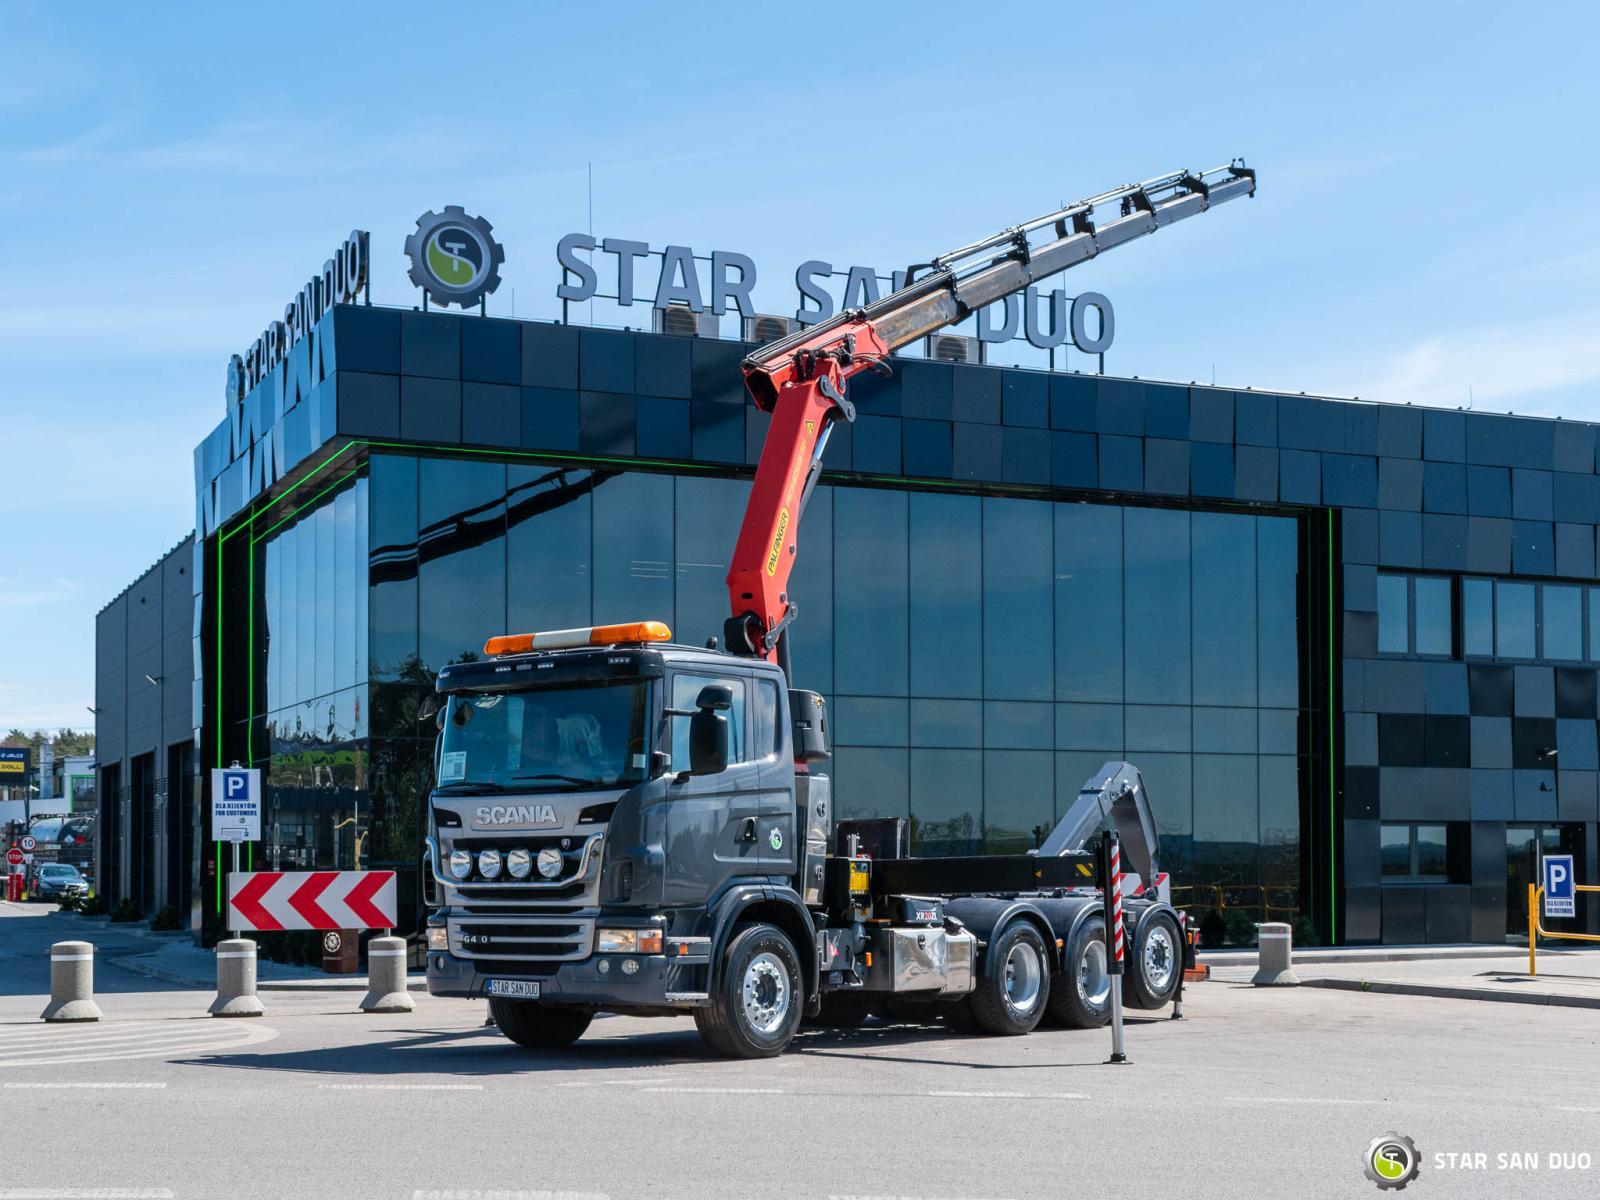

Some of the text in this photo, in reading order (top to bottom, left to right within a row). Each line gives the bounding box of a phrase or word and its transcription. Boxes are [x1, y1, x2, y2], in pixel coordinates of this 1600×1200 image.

[556, 233, 756, 318] STAR
[975, 286, 1115, 353] DUO
[245, 230, 367, 393] STAR SAN DUO
[768, 512, 788, 574] PALFINGER
[228, 776, 244, 797] P
[476, 805, 557, 825] SCANIA
[24, 839, 34, 847] 10
[8, 852, 23, 860] STOP
[1550, 864, 1566, 893] P
[492, 981, 538, 995] STAR SAN DUO
